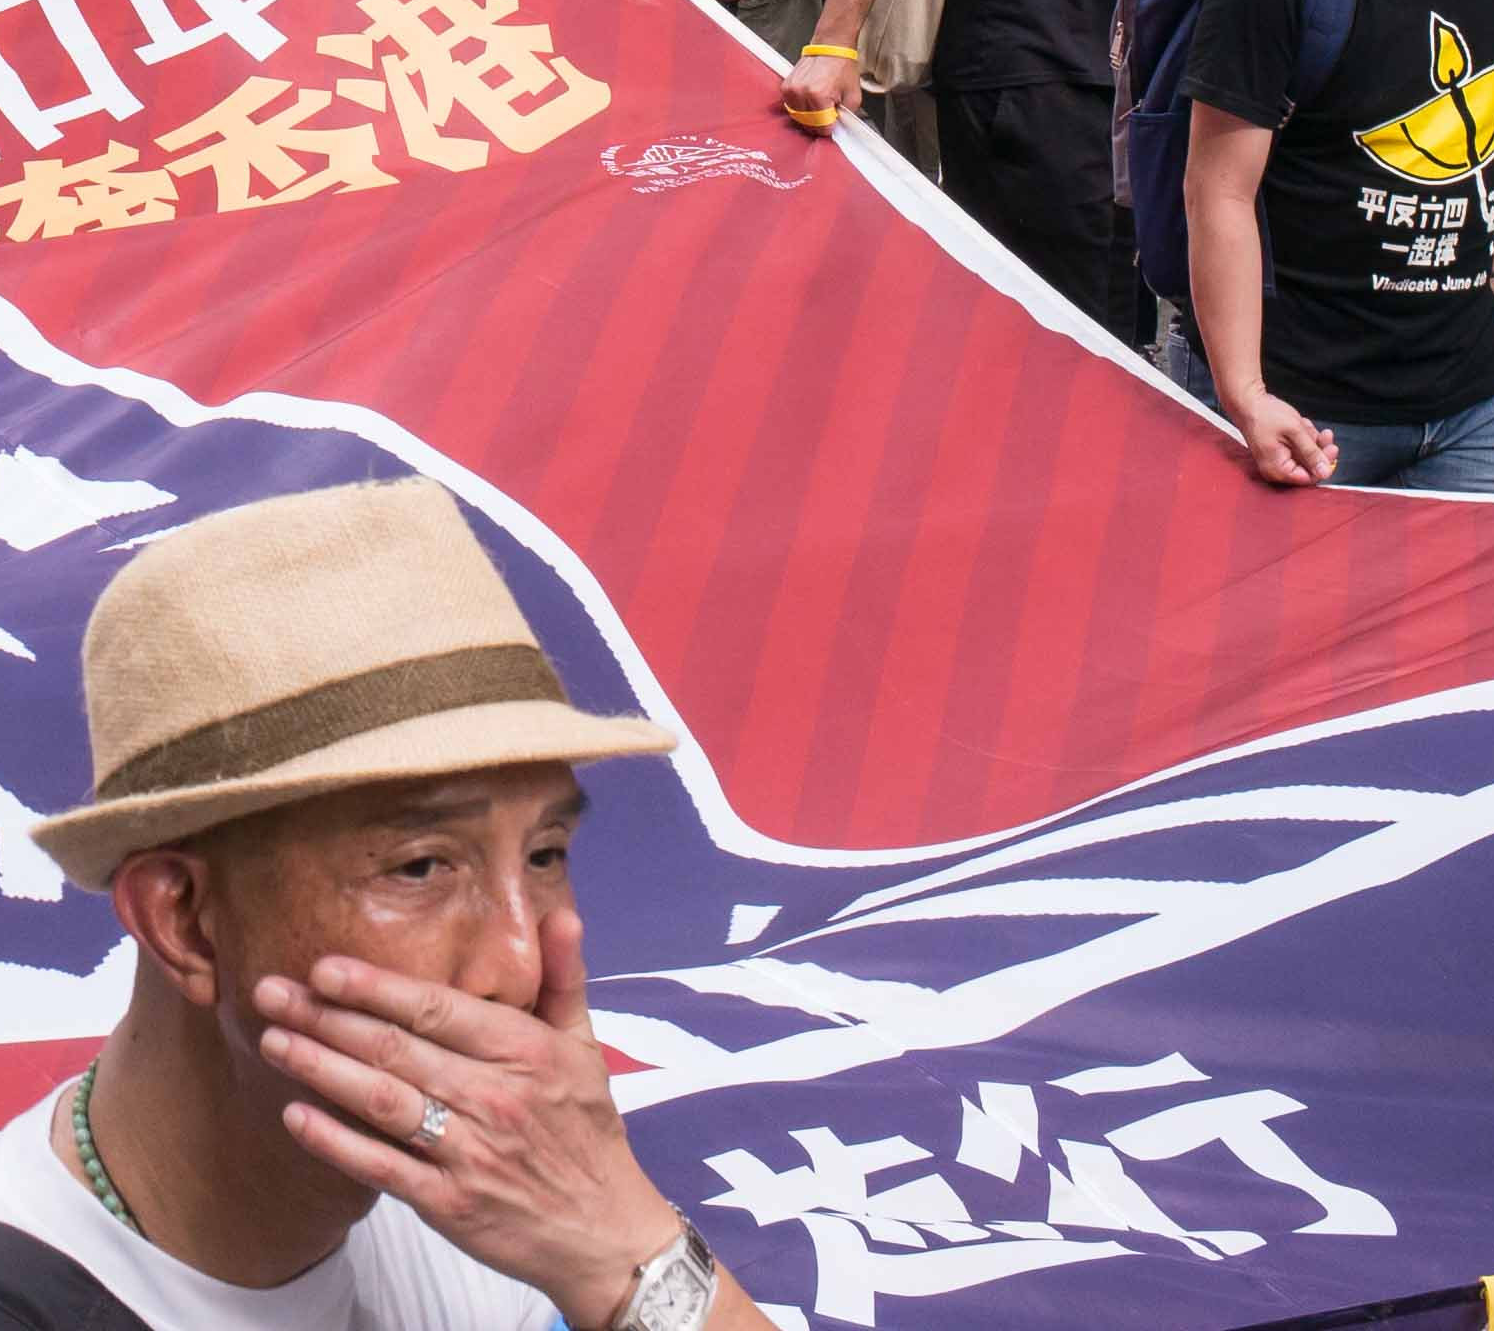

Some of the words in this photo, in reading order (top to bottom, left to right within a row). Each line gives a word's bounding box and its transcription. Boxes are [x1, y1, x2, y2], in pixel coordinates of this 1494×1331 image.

[1357, 187, 1469, 229] 平反六四
[1381, 232, 1460, 267] 一起撐
[1372, 274, 1439, 292] Vindicate
[1441, 274, 1472, 292] June
